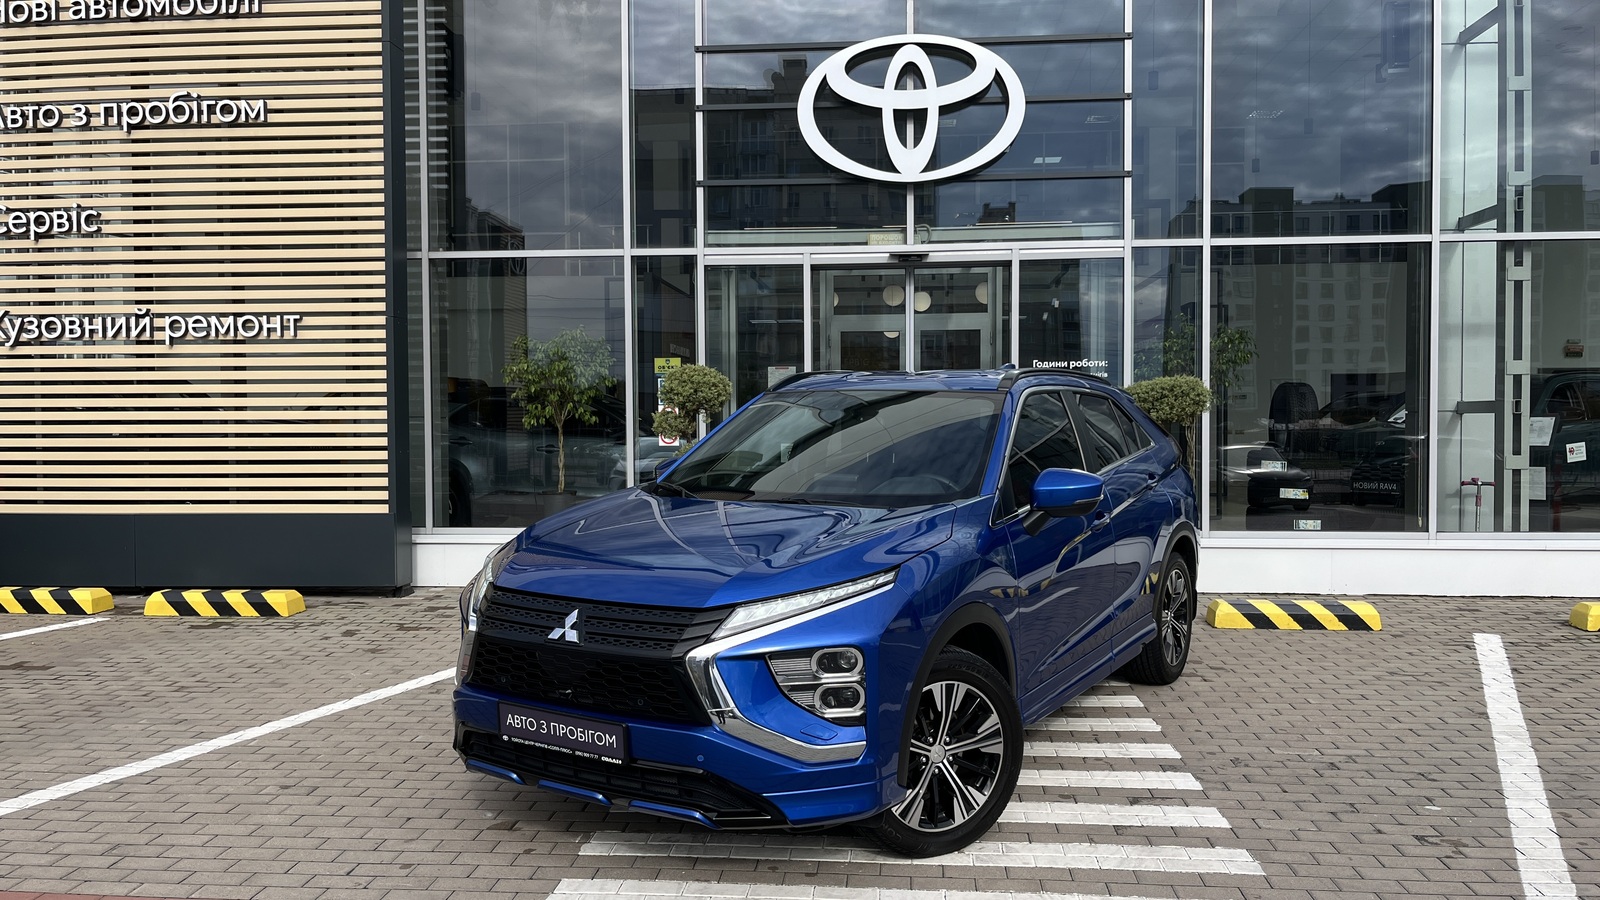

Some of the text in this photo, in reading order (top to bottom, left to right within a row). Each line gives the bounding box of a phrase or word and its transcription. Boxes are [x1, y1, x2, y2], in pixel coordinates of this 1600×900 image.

[0, 0, 57, 23] ові
[70, 103, 88, 126] з
[100, 91, 267, 132] пробігом
[164, 313, 300, 346] ремонт
[1032, 358, 1108, 369] Години роботи:
[1352, 480, 1397, 490] НОВИЙ RAV4
[506, 713, 617, 749] АВТО З ПРОБІГОМ
